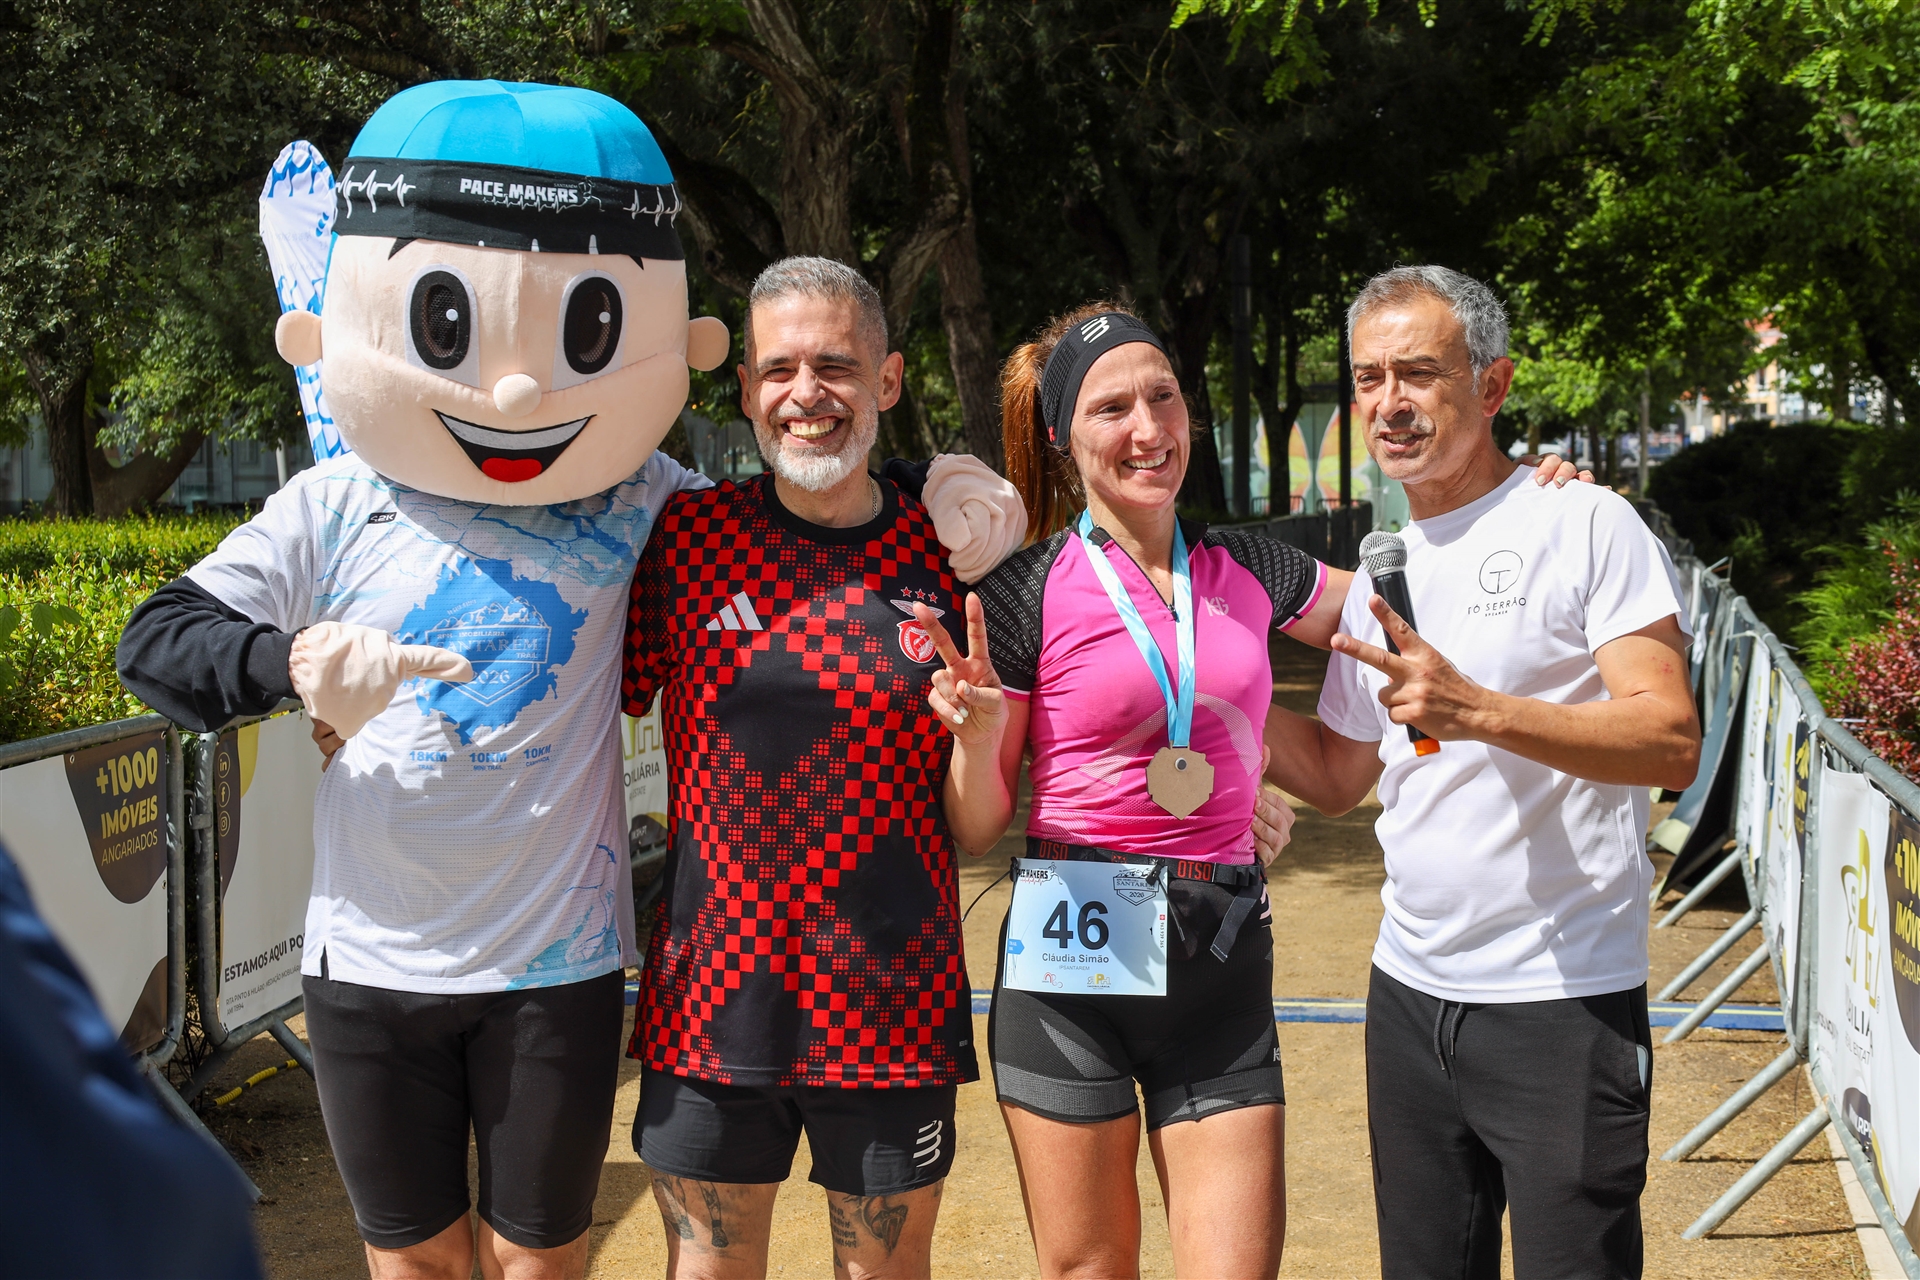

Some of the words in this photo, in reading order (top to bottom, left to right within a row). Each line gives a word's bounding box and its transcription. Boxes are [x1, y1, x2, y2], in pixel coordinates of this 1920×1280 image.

[460, 178, 504, 197] PACE
[509, 183, 578, 204] MAKERS
[1485, 596, 1526, 611] SERRÃO
[409, 750, 448, 763] 18KM
[469, 752, 508, 763] 10KM
[523, 743, 552, 760] 10KM
[96, 747, 158, 797] +1000
[101, 795, 158, 840] IMÓVEIS
[101, 829, 158, 867] ANGARIADOS
[1039, 841, 1069, 861] OTSO
[1027, 869, 1049, 880] MAKERS
[1177, 859, 1212, 882] OTSO
[1042, 900, 1110, 951] 46
[224, 951, 268, 983] ESTAMOS
[269, 940, 288, 963] AQUI
[289, 933, 306, 952] PO
[1042, 952, 1076, 963] Cláudia
[1078, 954, 1110, 964] Simão
